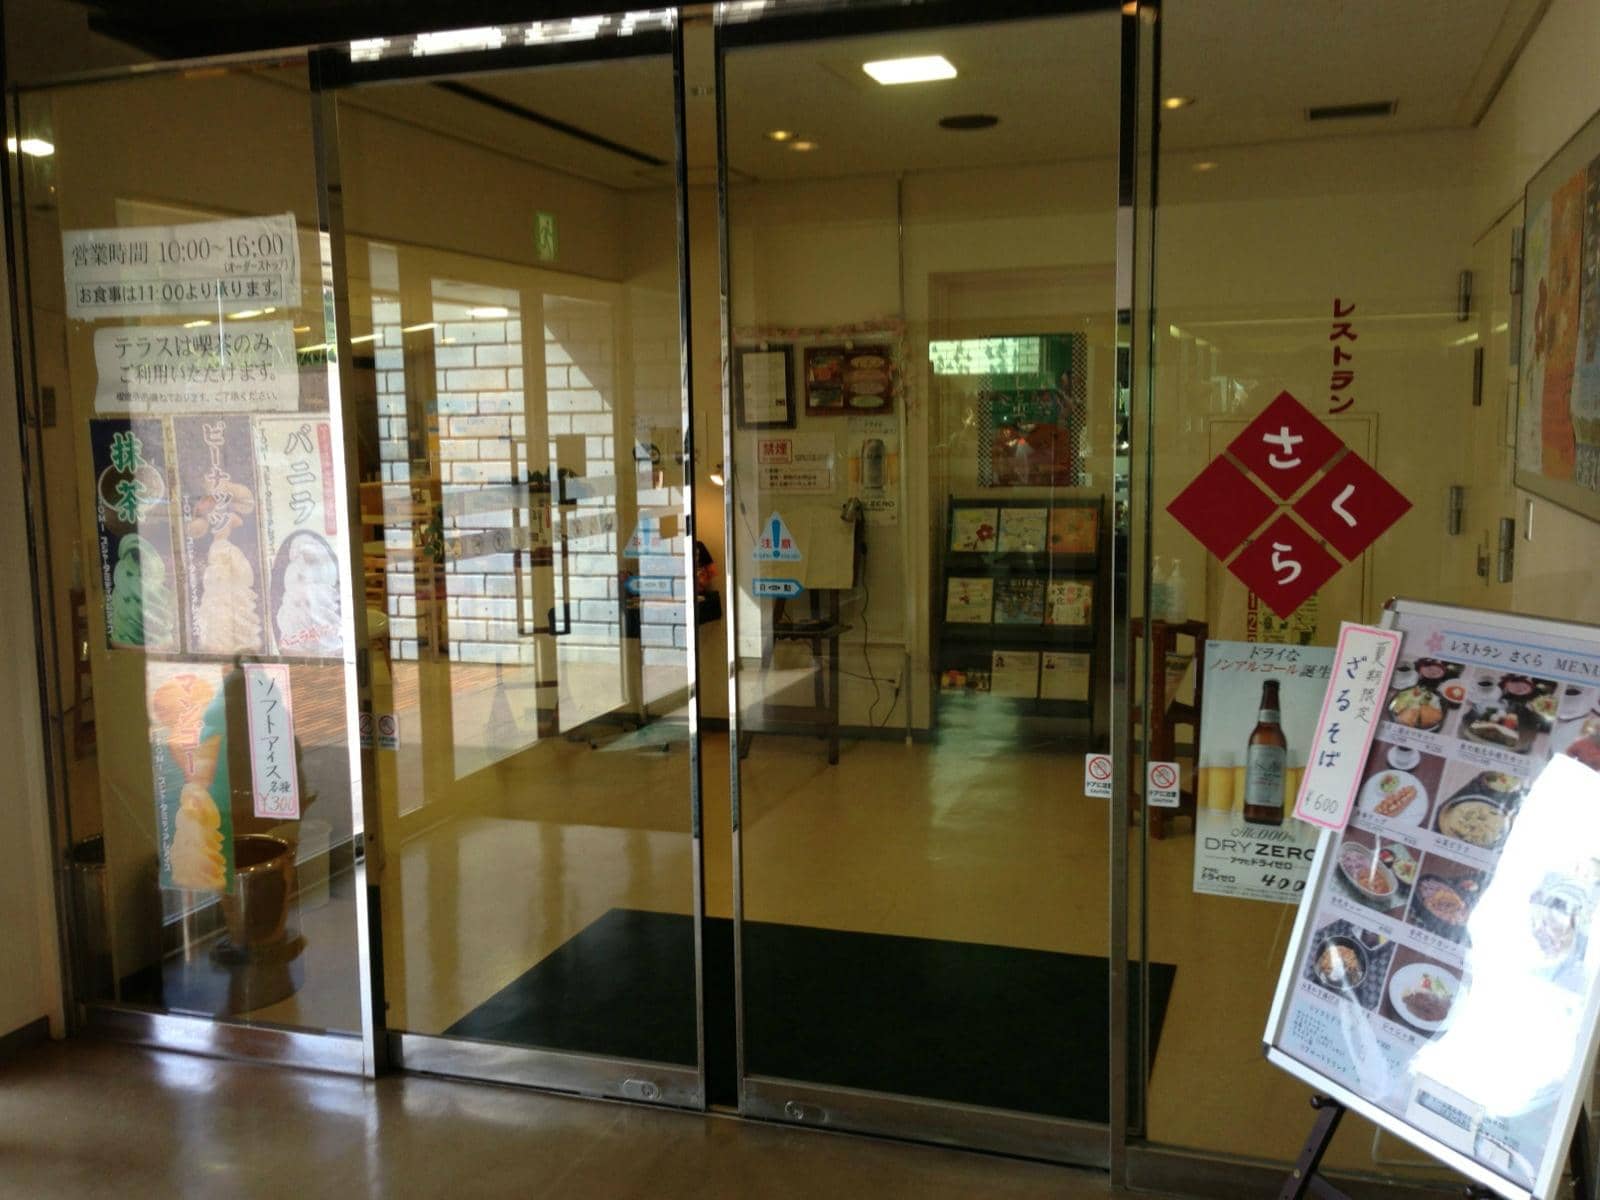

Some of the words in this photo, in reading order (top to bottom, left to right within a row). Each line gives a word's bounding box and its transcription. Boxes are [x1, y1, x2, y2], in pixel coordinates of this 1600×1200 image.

[73, 240, 148, 267] 営業時間
[115, 332, 273, 359] テラスは喫茶のみ
[1329, 298, 1358, 415] レストラン
[120, 359, 277, 384] ご利用いただけます。
[111, 431, 146, 523] 抹茶
[1263, 427, 1357, 585] さくら
[1250, 646, 1300, 662] ドライな
[1450, 639, 1502, 659] レストラン
[1508, 650, 1543, 667] さくら
[1317, 655, 1367, 768] ざるそば
[257, 678, 281, 780] ソフトアイス
[1205, 837, 1251, 854] DRY
[1262, 874, 1306, 892] 400
